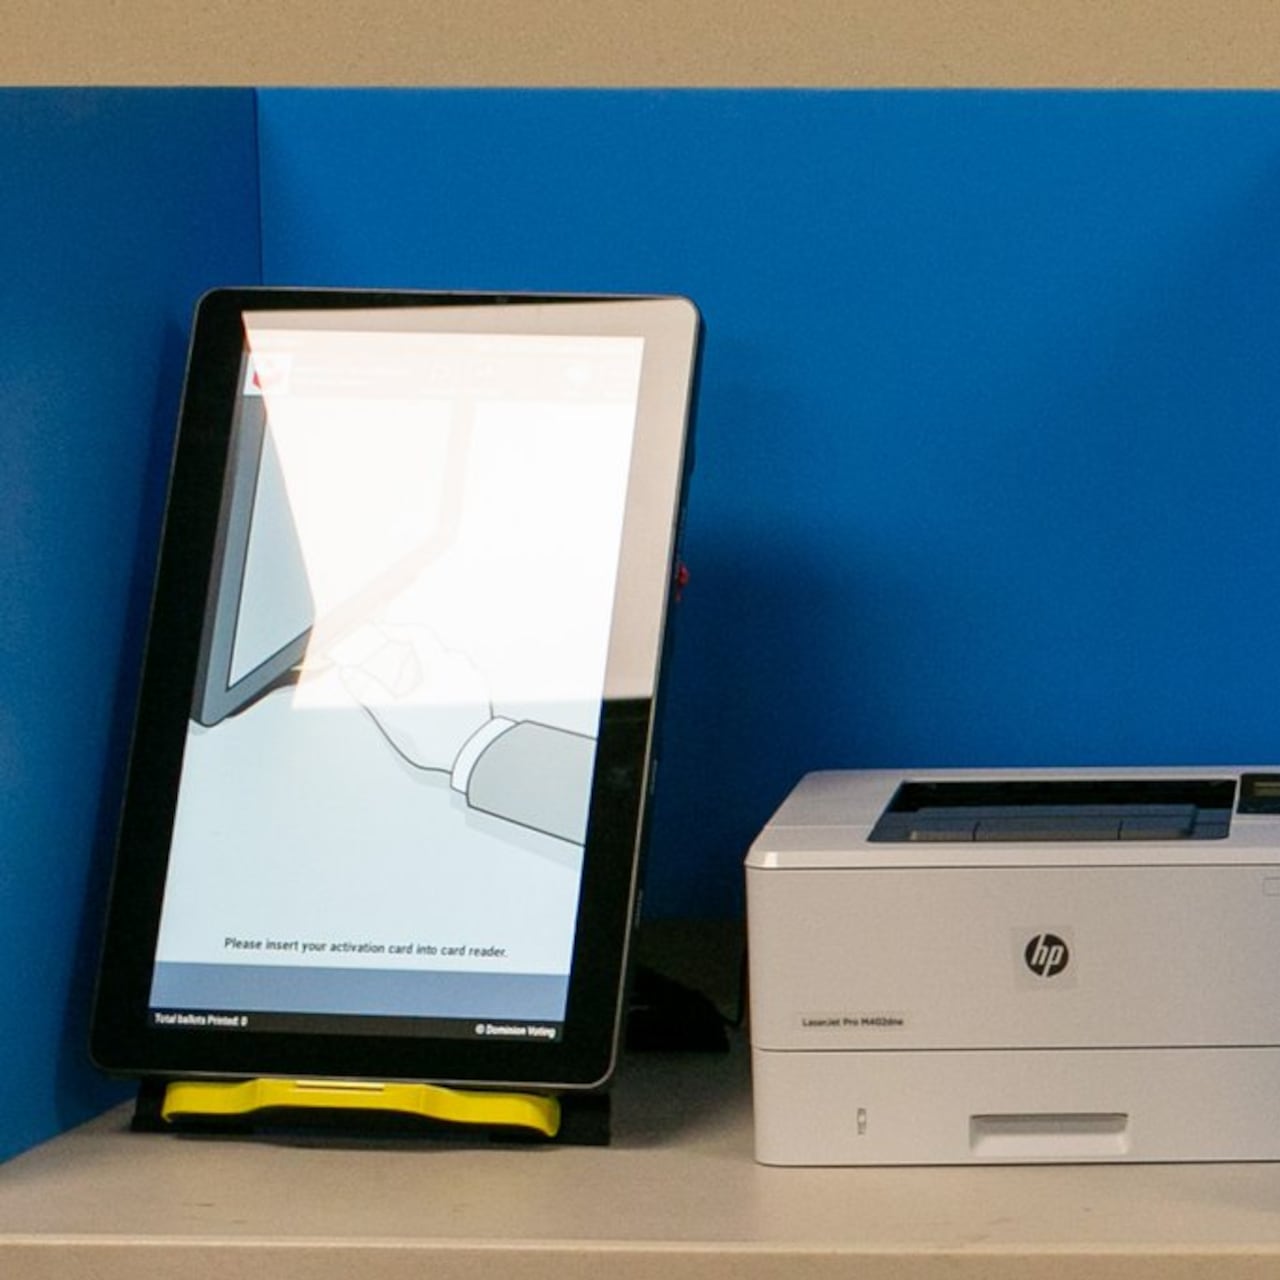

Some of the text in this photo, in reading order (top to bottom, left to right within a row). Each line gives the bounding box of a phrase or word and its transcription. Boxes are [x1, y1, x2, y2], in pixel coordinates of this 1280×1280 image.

[223, 937, 509, 957] Please insert your activation card into card reader.
[1025, 934, 1069, 977] hp
[154, 1012, 176, 1024] Total
[802, 1017, 840, 1028] LaserJet
[843, 1017, 859, 1027] Pro
[486, 1023, 526, 1036] Dominion
[527, 1025, 557, 1039] Voting
